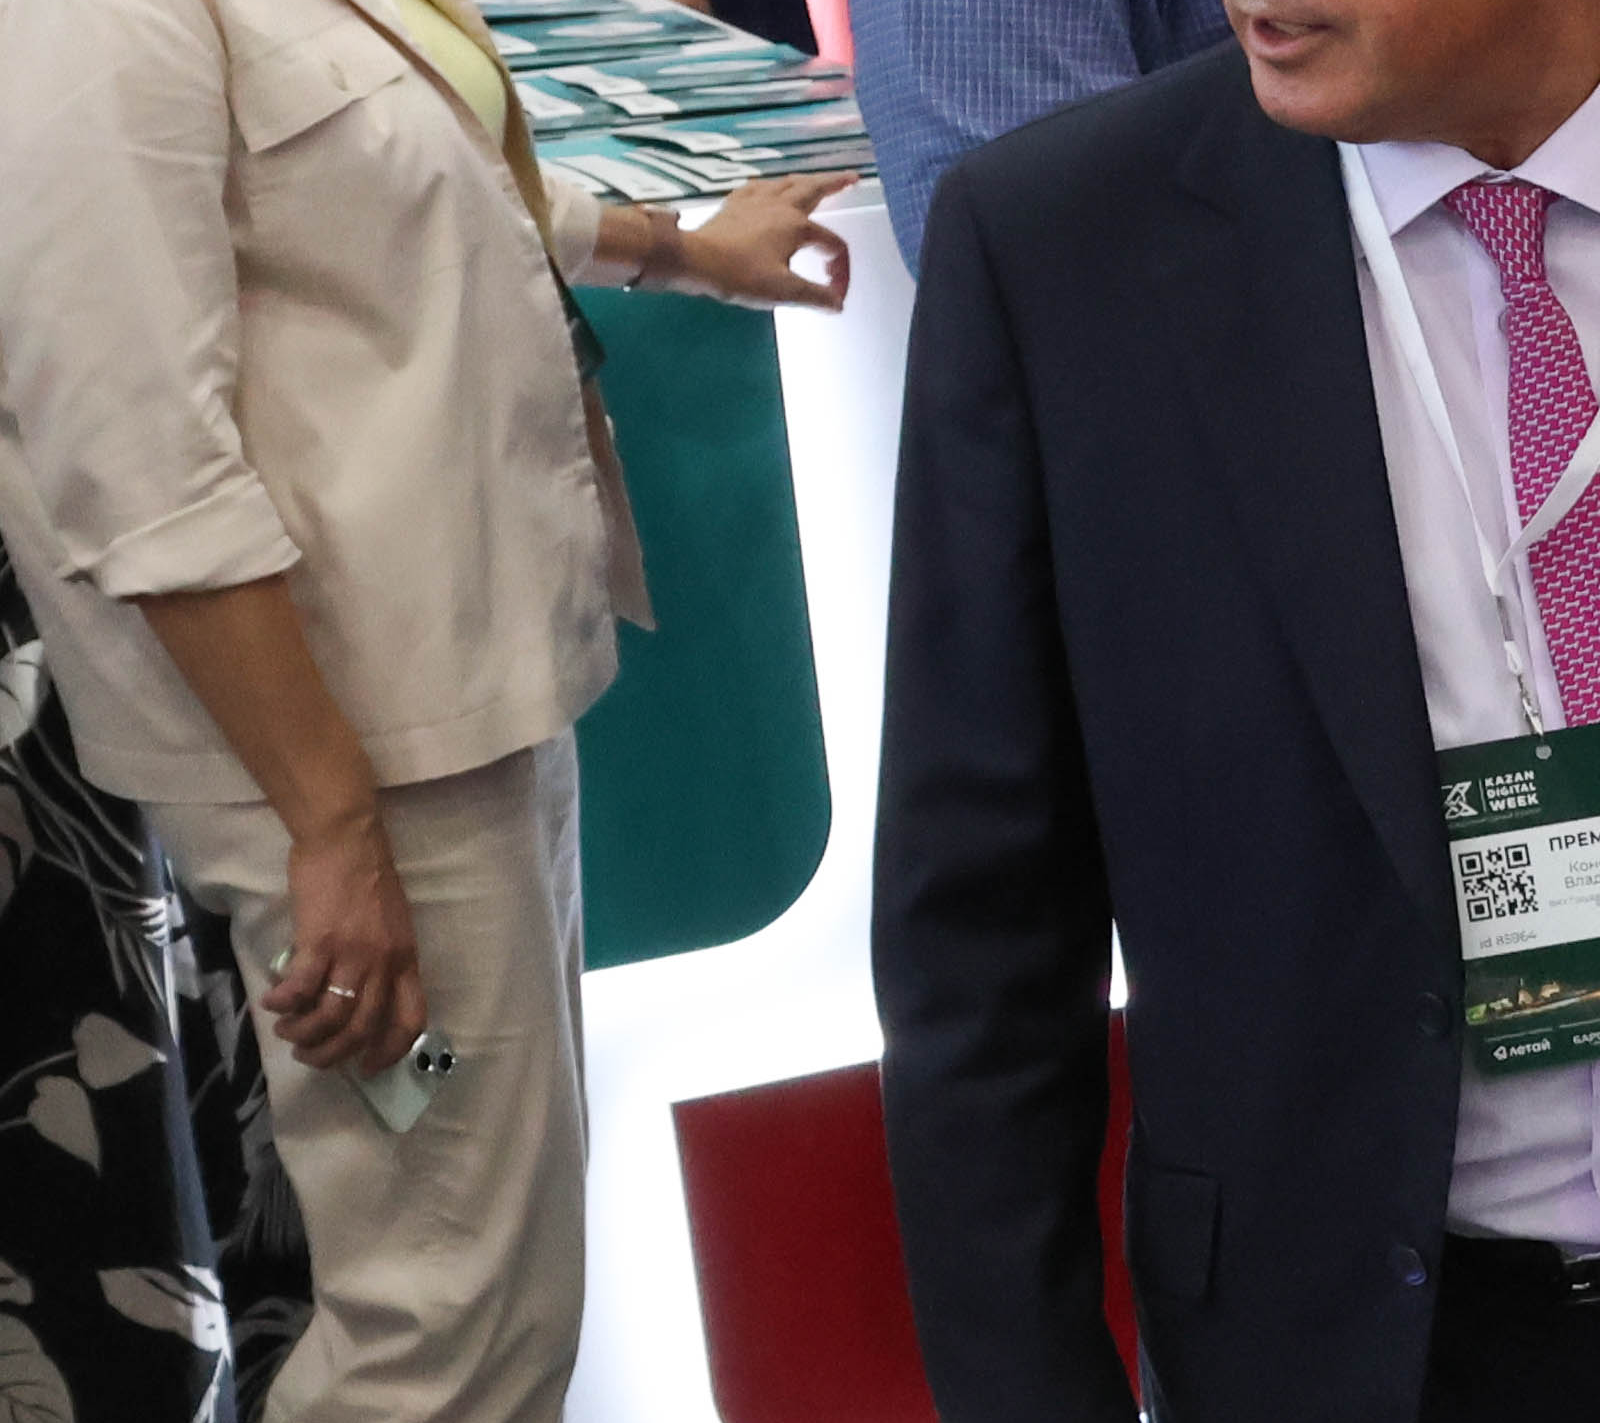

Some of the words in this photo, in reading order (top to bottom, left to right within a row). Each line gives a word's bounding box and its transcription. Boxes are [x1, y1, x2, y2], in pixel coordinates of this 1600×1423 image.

[1484, 769, 1535, 787] KAZAN
[1486, 782, 1537, 799] DIGITAL
[1488, 793, 1539, 812] WEEK
